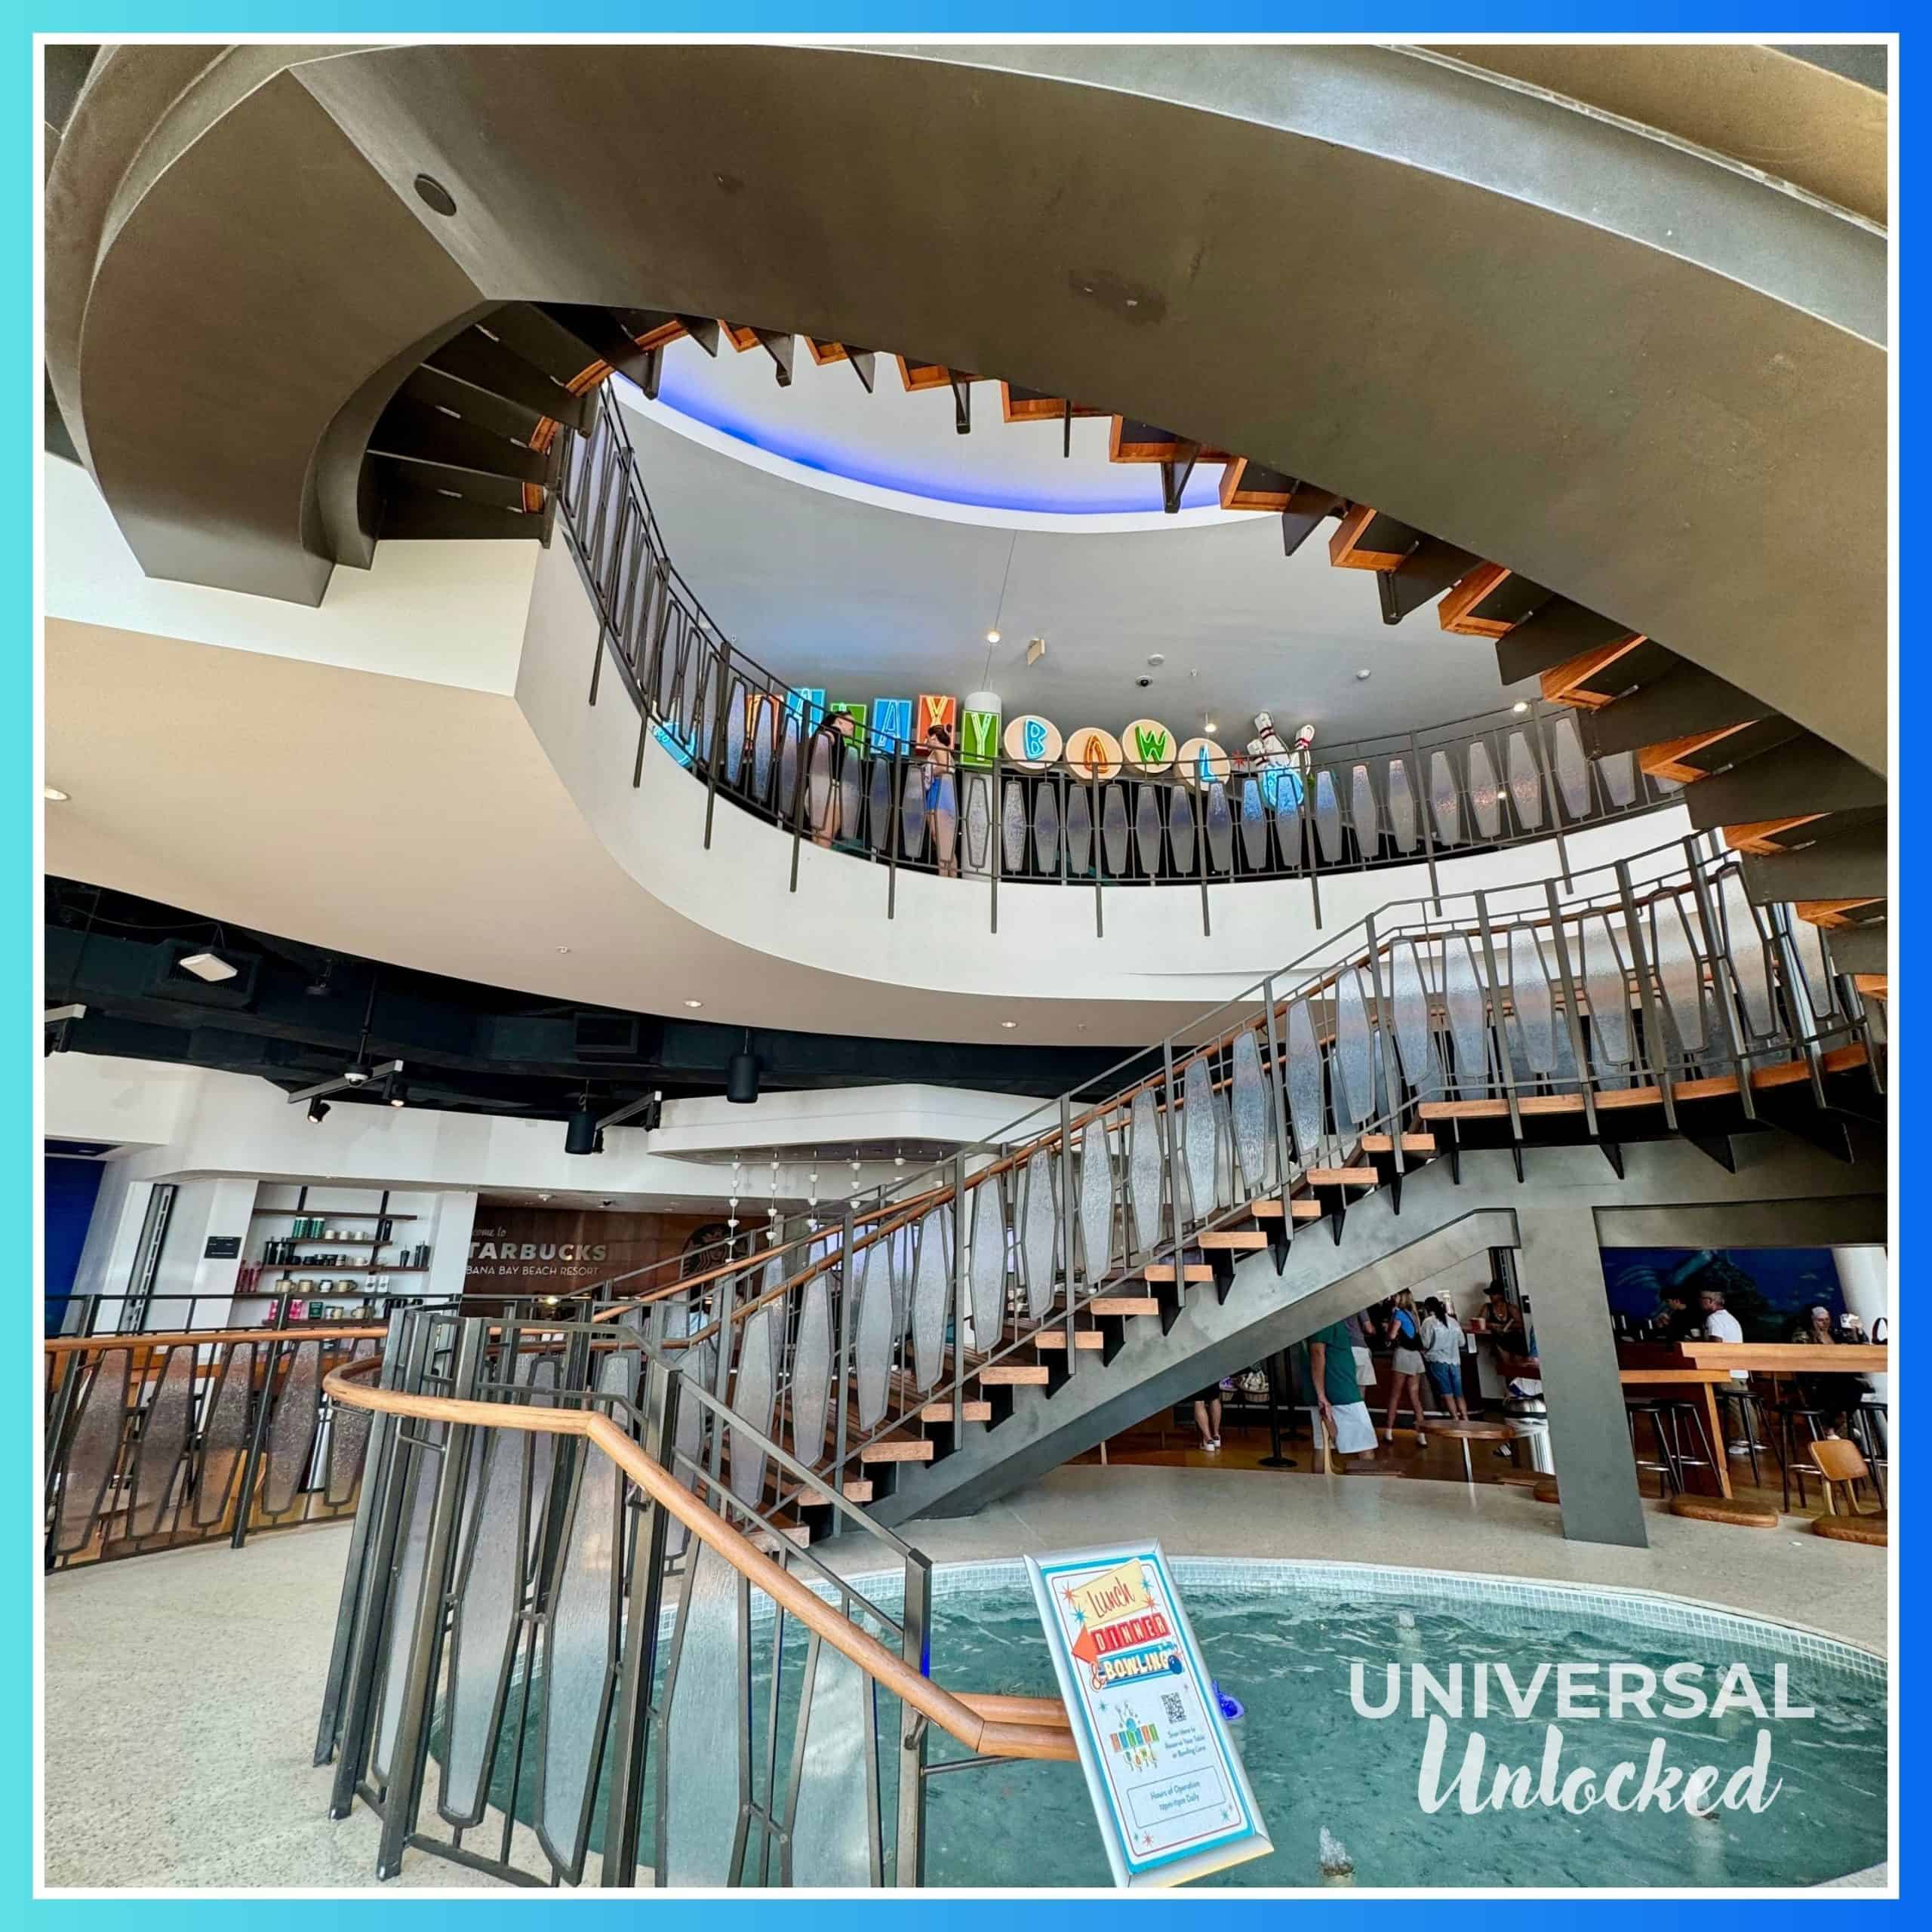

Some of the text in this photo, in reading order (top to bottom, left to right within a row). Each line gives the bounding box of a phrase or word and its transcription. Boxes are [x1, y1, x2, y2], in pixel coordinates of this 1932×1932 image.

[498, 1266, 520, 1275] BAY
[522, 1266, 557, 1275] BEACH
[560, 1266, 598, 1276] RESORT
[1087, 1576, 1136, 1619] Lunch
[1095, 1615, 1167, 1652] DINNER
[1104, 1651, 1169, 1681] BOWLING
